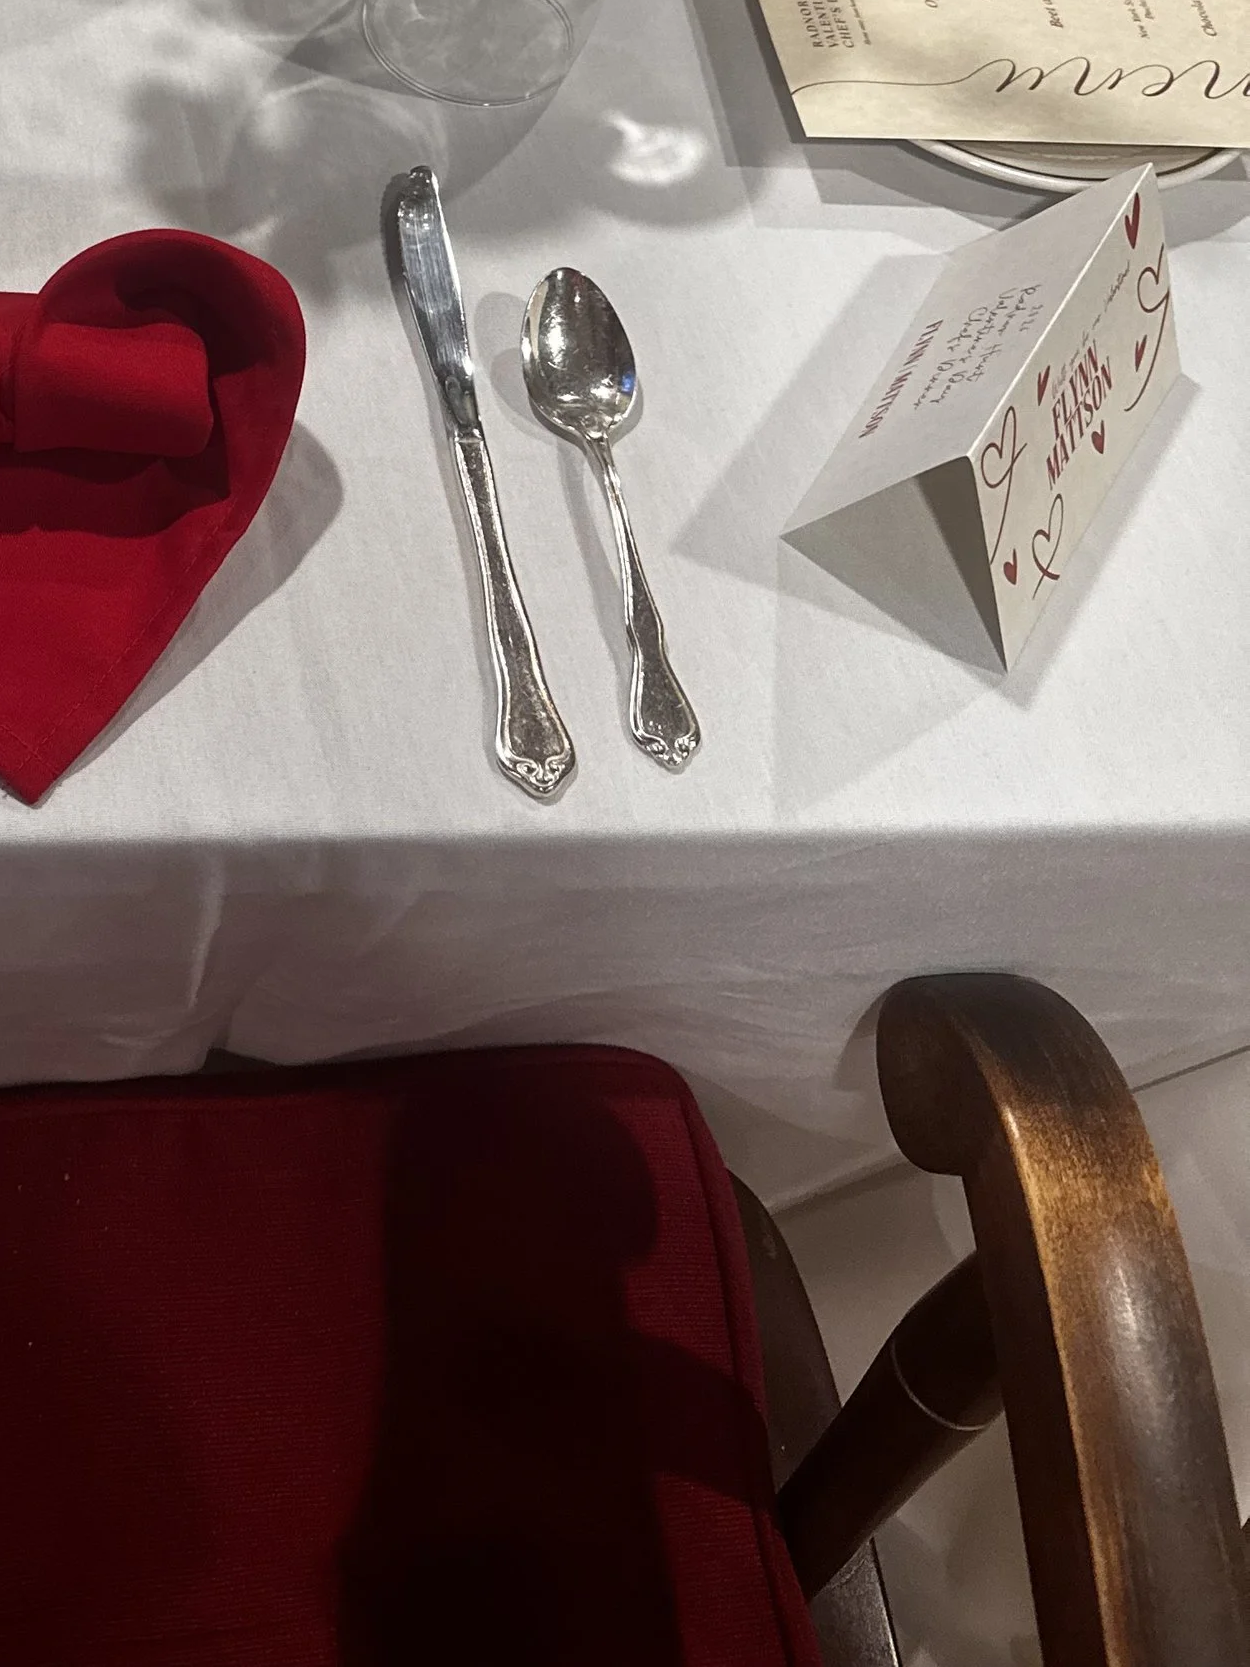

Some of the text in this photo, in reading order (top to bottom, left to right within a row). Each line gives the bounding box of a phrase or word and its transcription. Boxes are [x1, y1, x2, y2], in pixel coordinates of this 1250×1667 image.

[797, 0, 824, 47] RADNOR
[830, 7, 855, 48] CHEF'S
[1046, 6, 1064, 28] Beet
[858, 370, 912, 439] MATTSON
[1051, 338, 1099, 441] FLYNN
[1045, 355, 1113, 492] MATTSON
